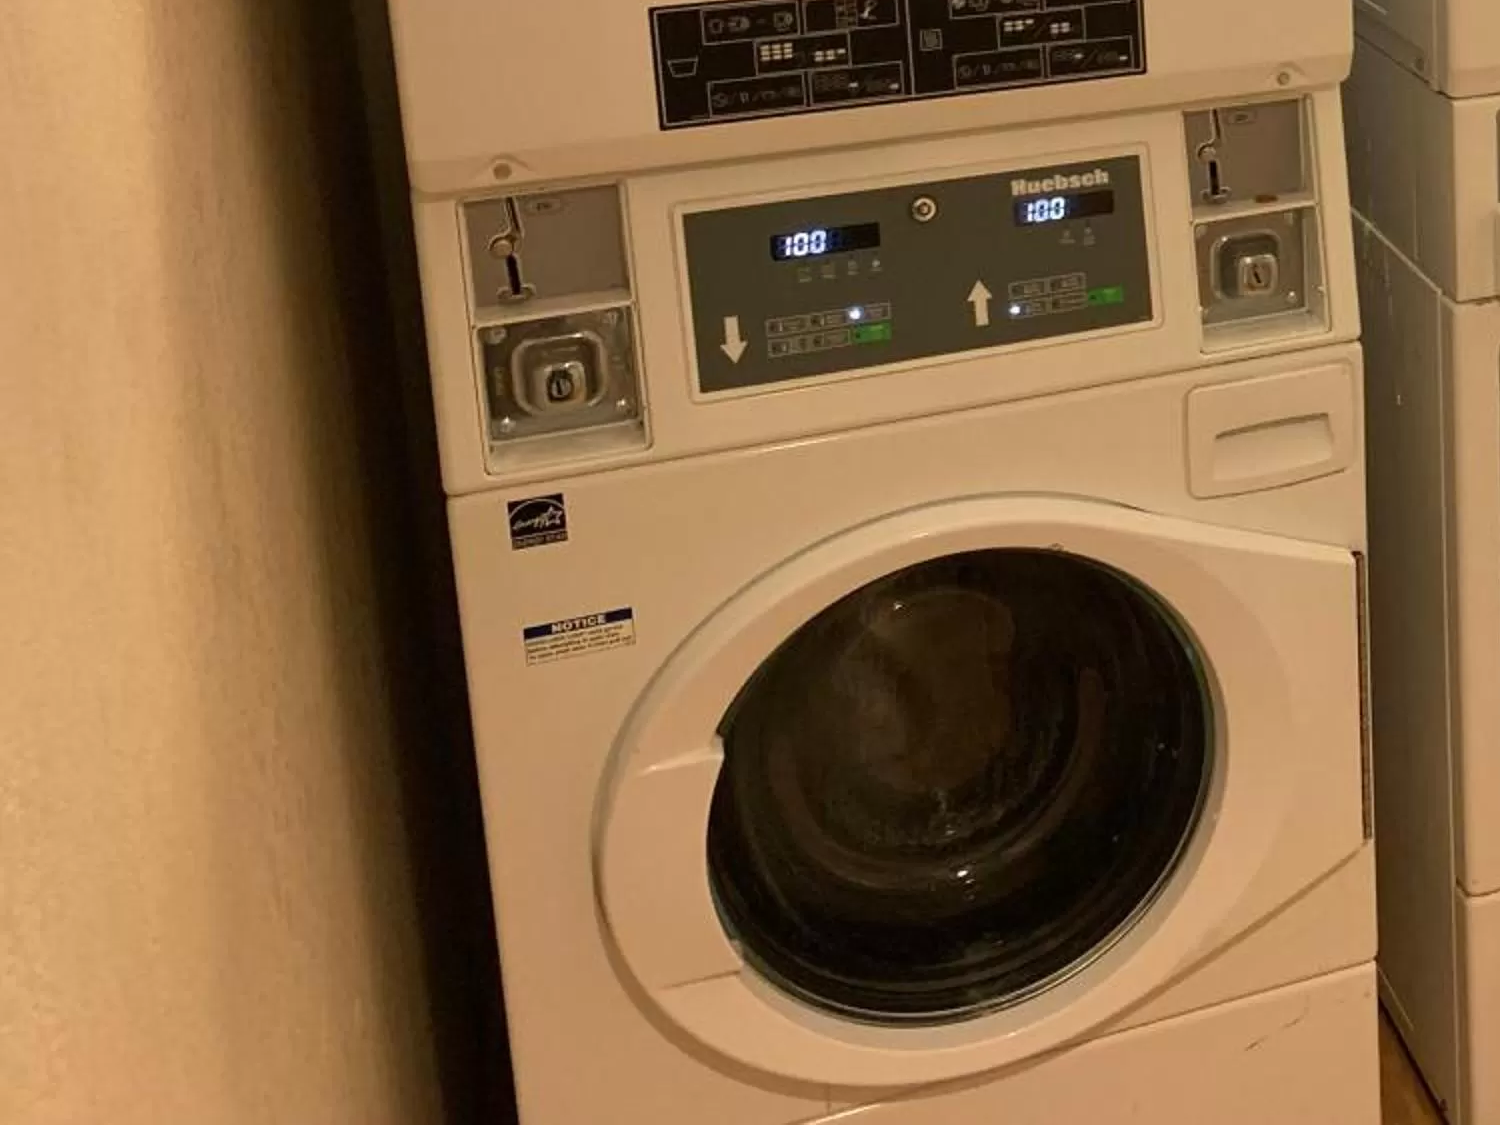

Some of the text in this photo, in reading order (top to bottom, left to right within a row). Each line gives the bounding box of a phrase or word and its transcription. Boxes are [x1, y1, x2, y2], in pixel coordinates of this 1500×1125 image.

[1010, 168, 1109, 196] Huebsch
[1026, 196, 1066, 222] 100
[785, 230, 827, 256] 100
[551, 614, 607, 634] NOTICE
